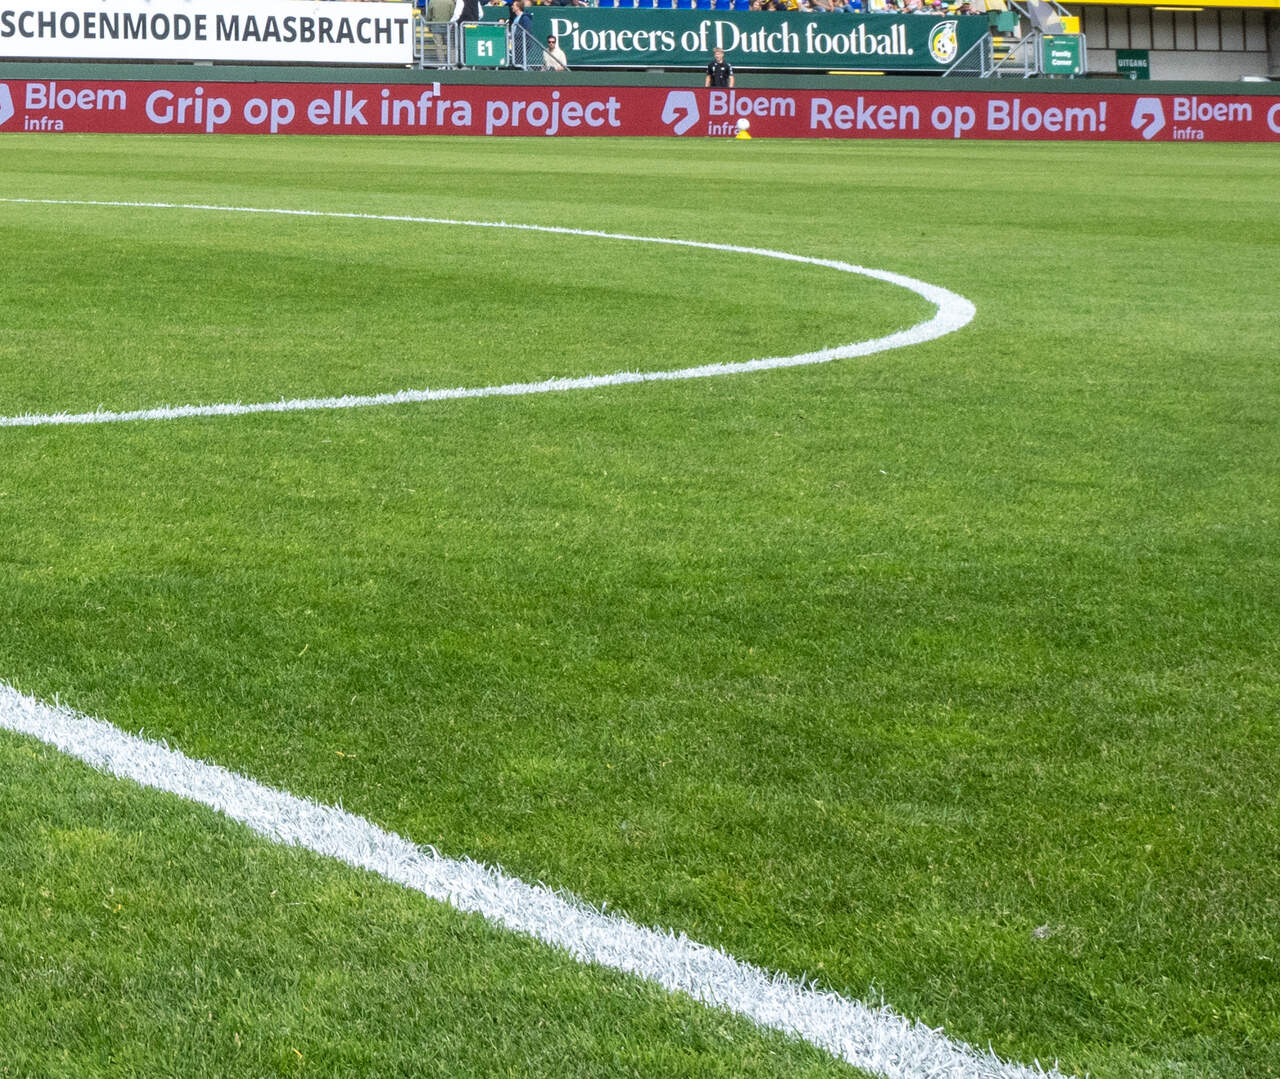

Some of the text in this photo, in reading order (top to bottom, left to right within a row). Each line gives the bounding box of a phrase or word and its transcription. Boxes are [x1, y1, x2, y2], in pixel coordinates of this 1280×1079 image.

[1, 8, 208, 41] SCHOENMODE
[215, 14, 409, 45] MAASBRACHT
[550, 18, 675, 51] Pioneers
[680, 19, 712, 52] of
[715, 20, 801, 54] Dutch
[806, 22, 914, 56] football.
[477, 40, 493, 57] E1
[1118, 58, 1147, 67] UITGANG
[25, 81, 127, 111] Bloem
[708, 90, 796, 117] Bloem
[1173, 97, 1252, 121] Bloem
[24, 115, 64, 131] infra
[145, 86, 621, 136] Grip op elk infra project
[810, 96, 1107, 138] Reken op Bloem!
[1173, 126, 1204, 140] infra
